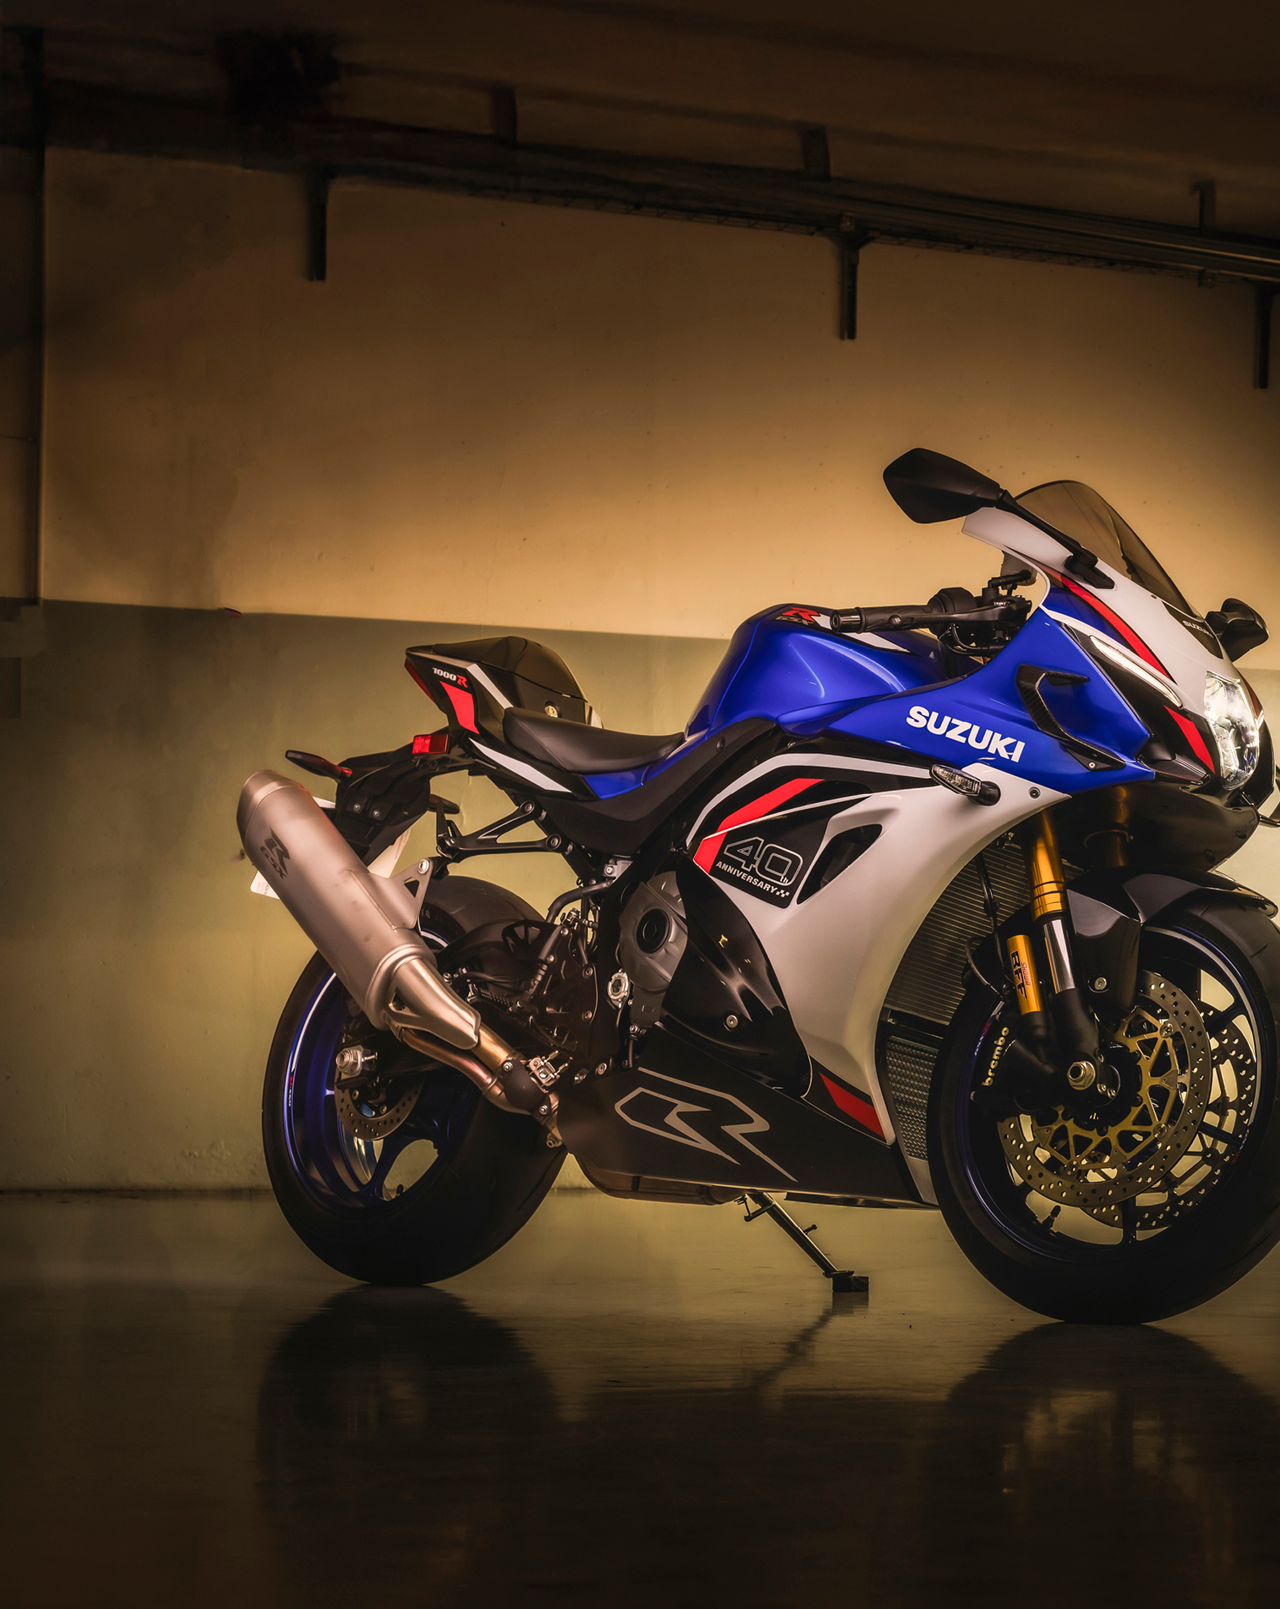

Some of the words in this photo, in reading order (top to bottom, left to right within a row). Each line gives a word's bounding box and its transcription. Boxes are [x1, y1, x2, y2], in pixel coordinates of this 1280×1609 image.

[906, 706, 1026, 763] SUZUKI
[715, 861, 779, 894] ANNIVERSARY
[982, 1026, 1010, 1087] brembo
